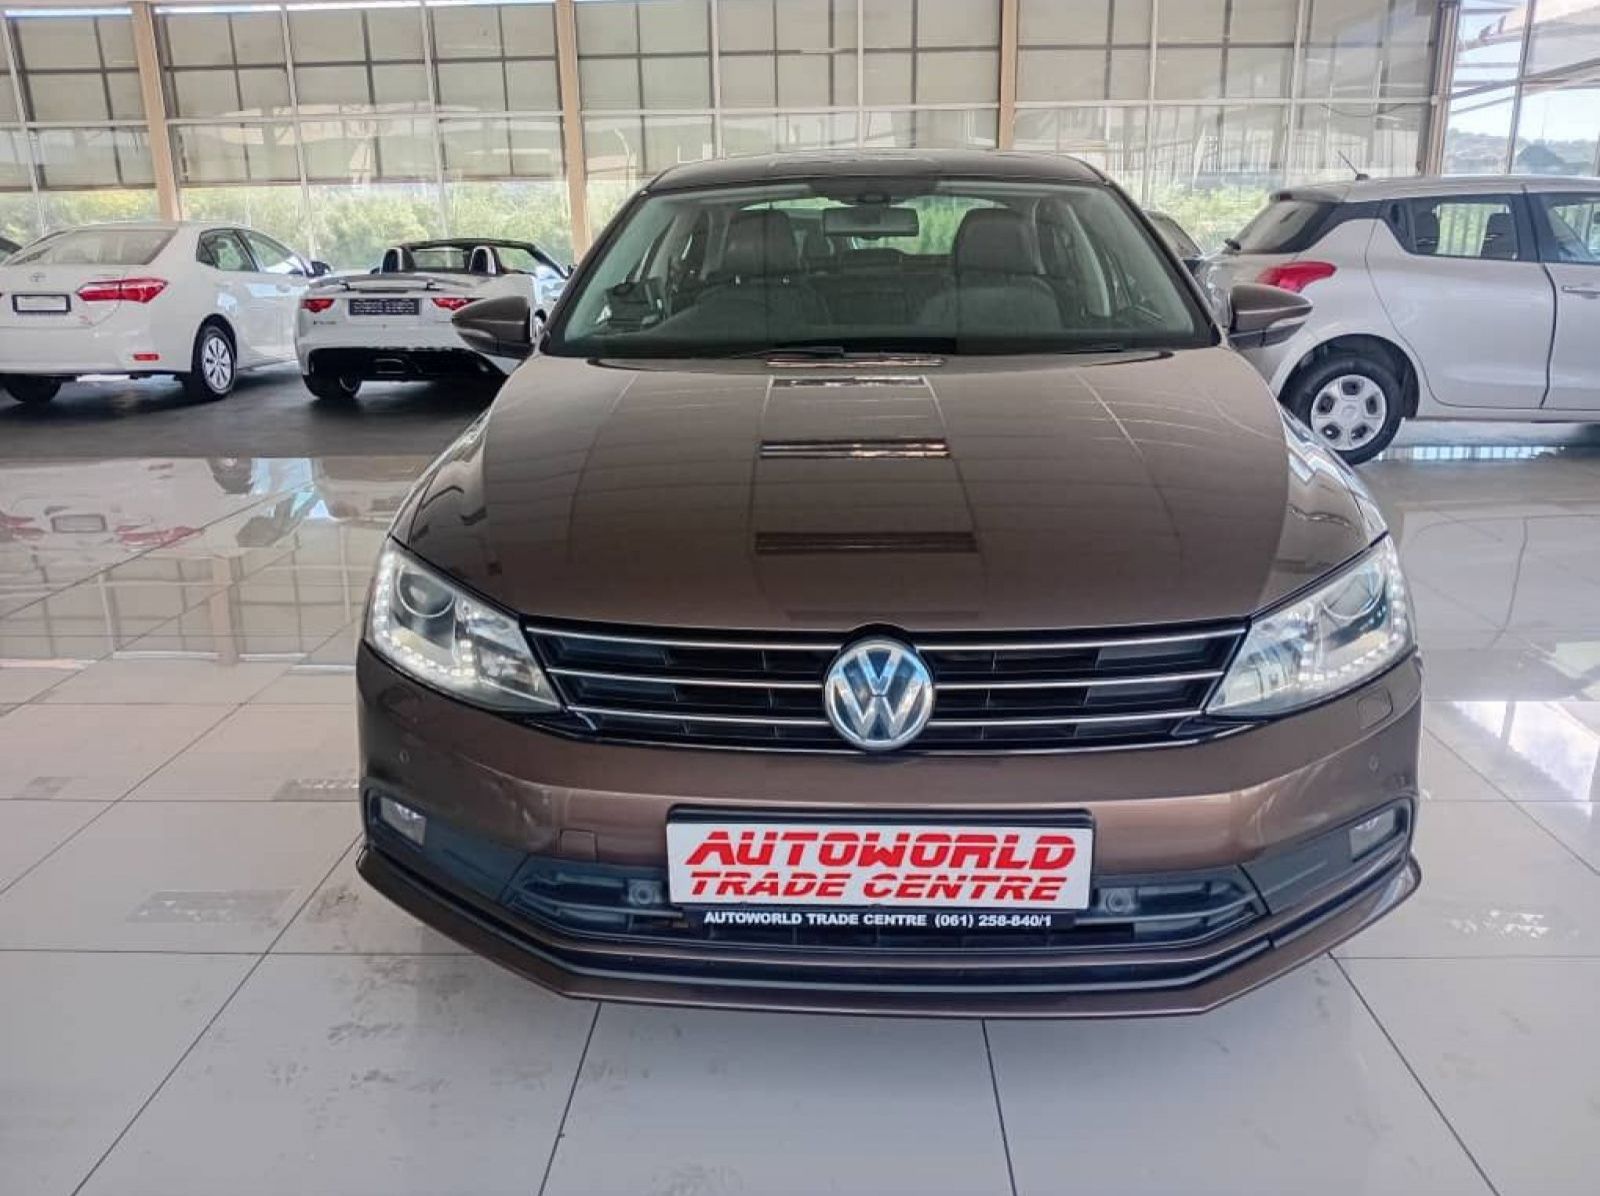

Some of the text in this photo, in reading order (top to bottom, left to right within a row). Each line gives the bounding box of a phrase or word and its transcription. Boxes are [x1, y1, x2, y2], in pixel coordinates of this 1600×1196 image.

[686, 831, 1076, 870] AUTOWORLD
[691, 872, 1067, 900] TRADE CENTRE
[704, 911, 802, 925] AUTOWORLD
[806, 913, 859, 926] TRADE
[863, 914, 927, 926] CENTRE
[934, 914, 974, 928] (061)
